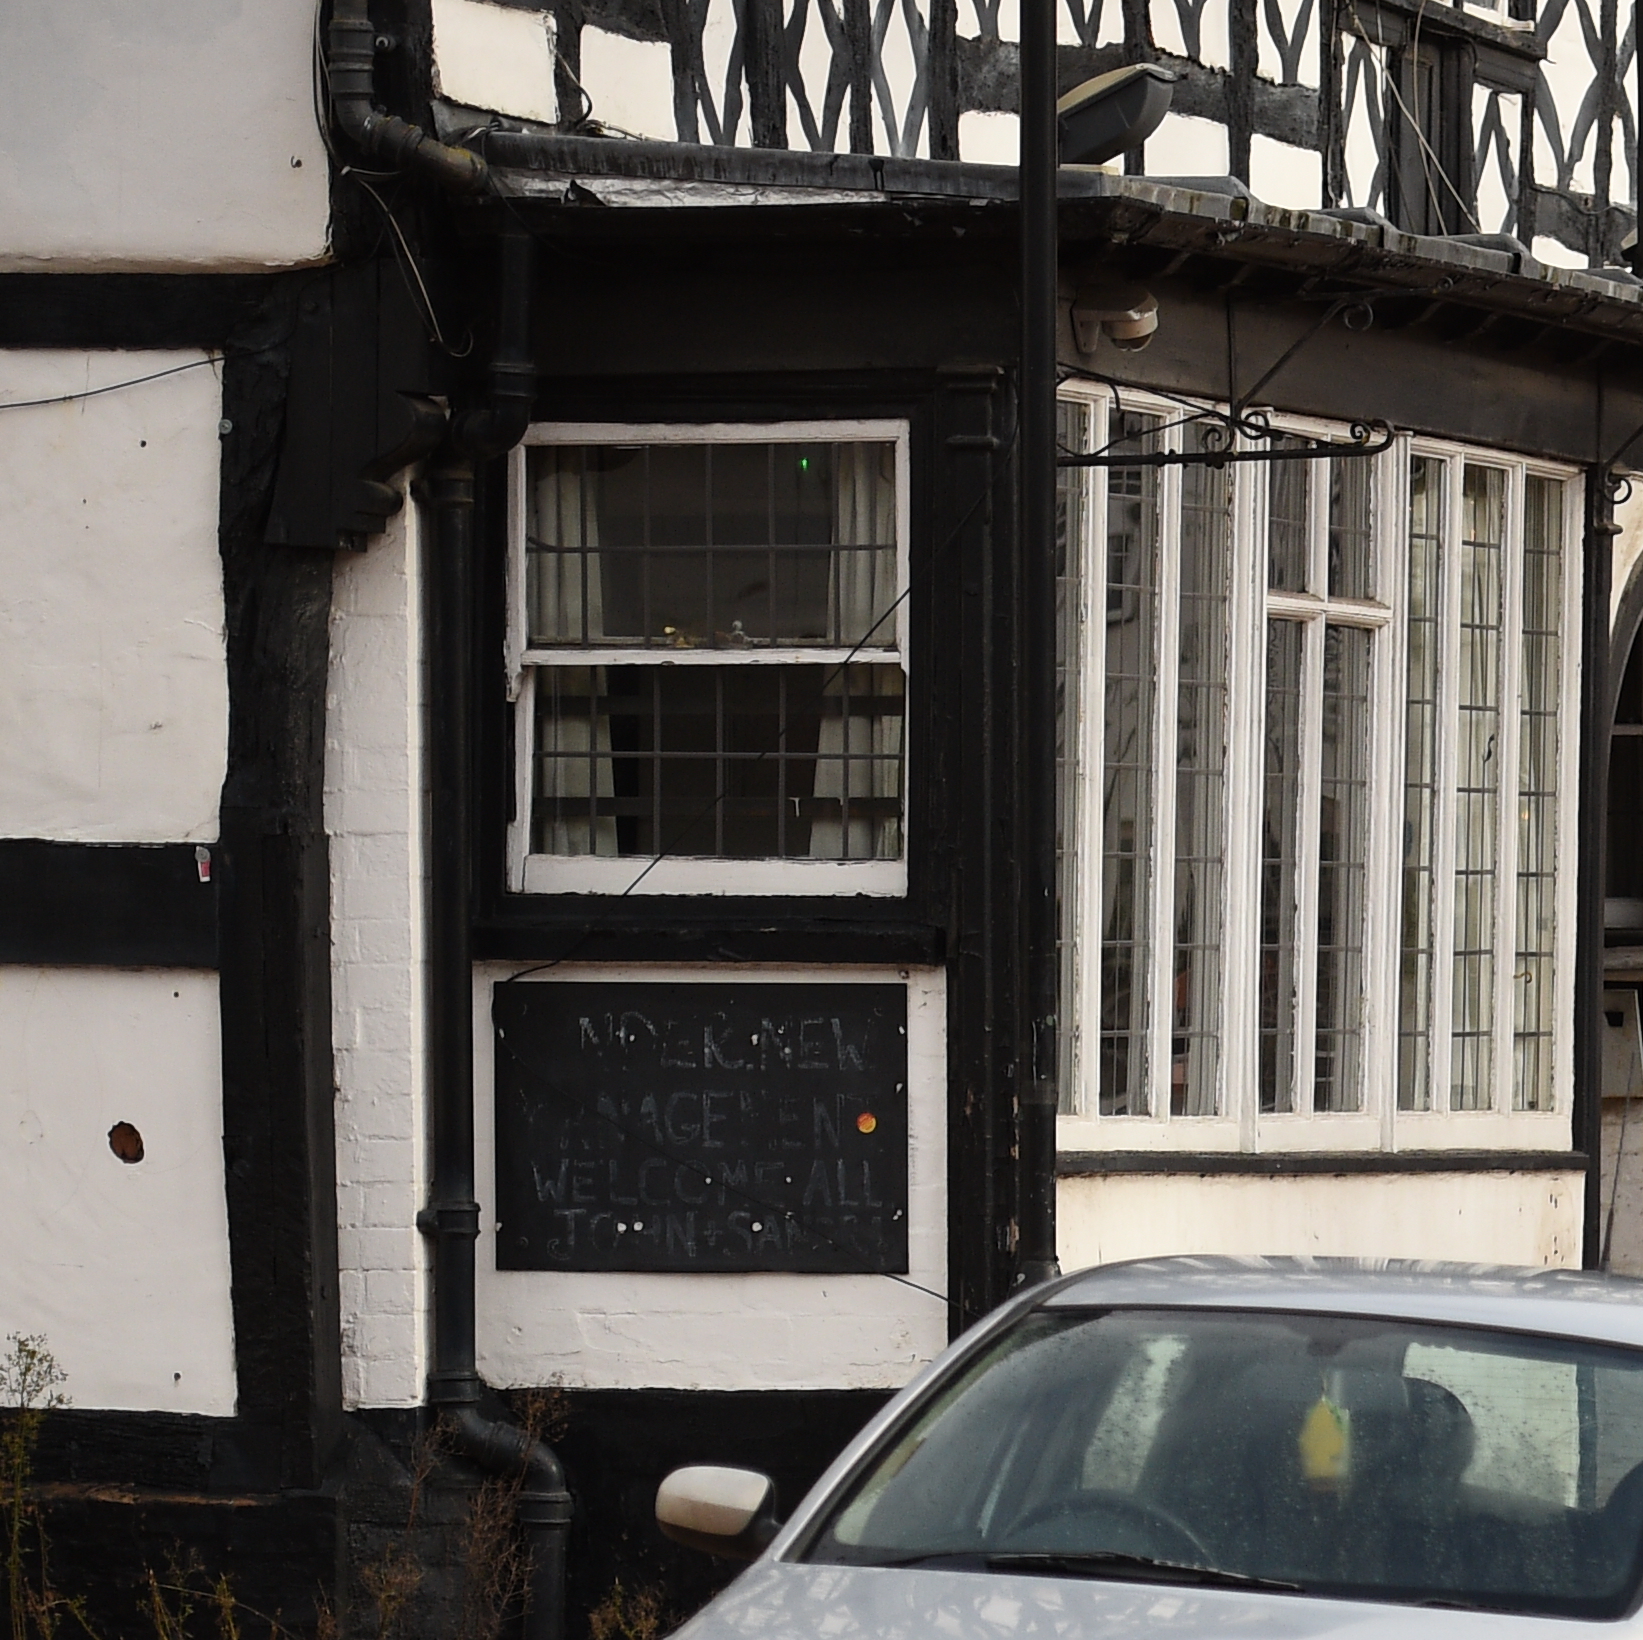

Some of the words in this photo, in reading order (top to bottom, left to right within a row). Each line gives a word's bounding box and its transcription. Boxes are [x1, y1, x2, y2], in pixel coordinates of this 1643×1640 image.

[760, 1014, 878, 1072] NEW
[530, 1157, 788, 1208] WELCOME
[802, 1157, 885, 1208] ALL
